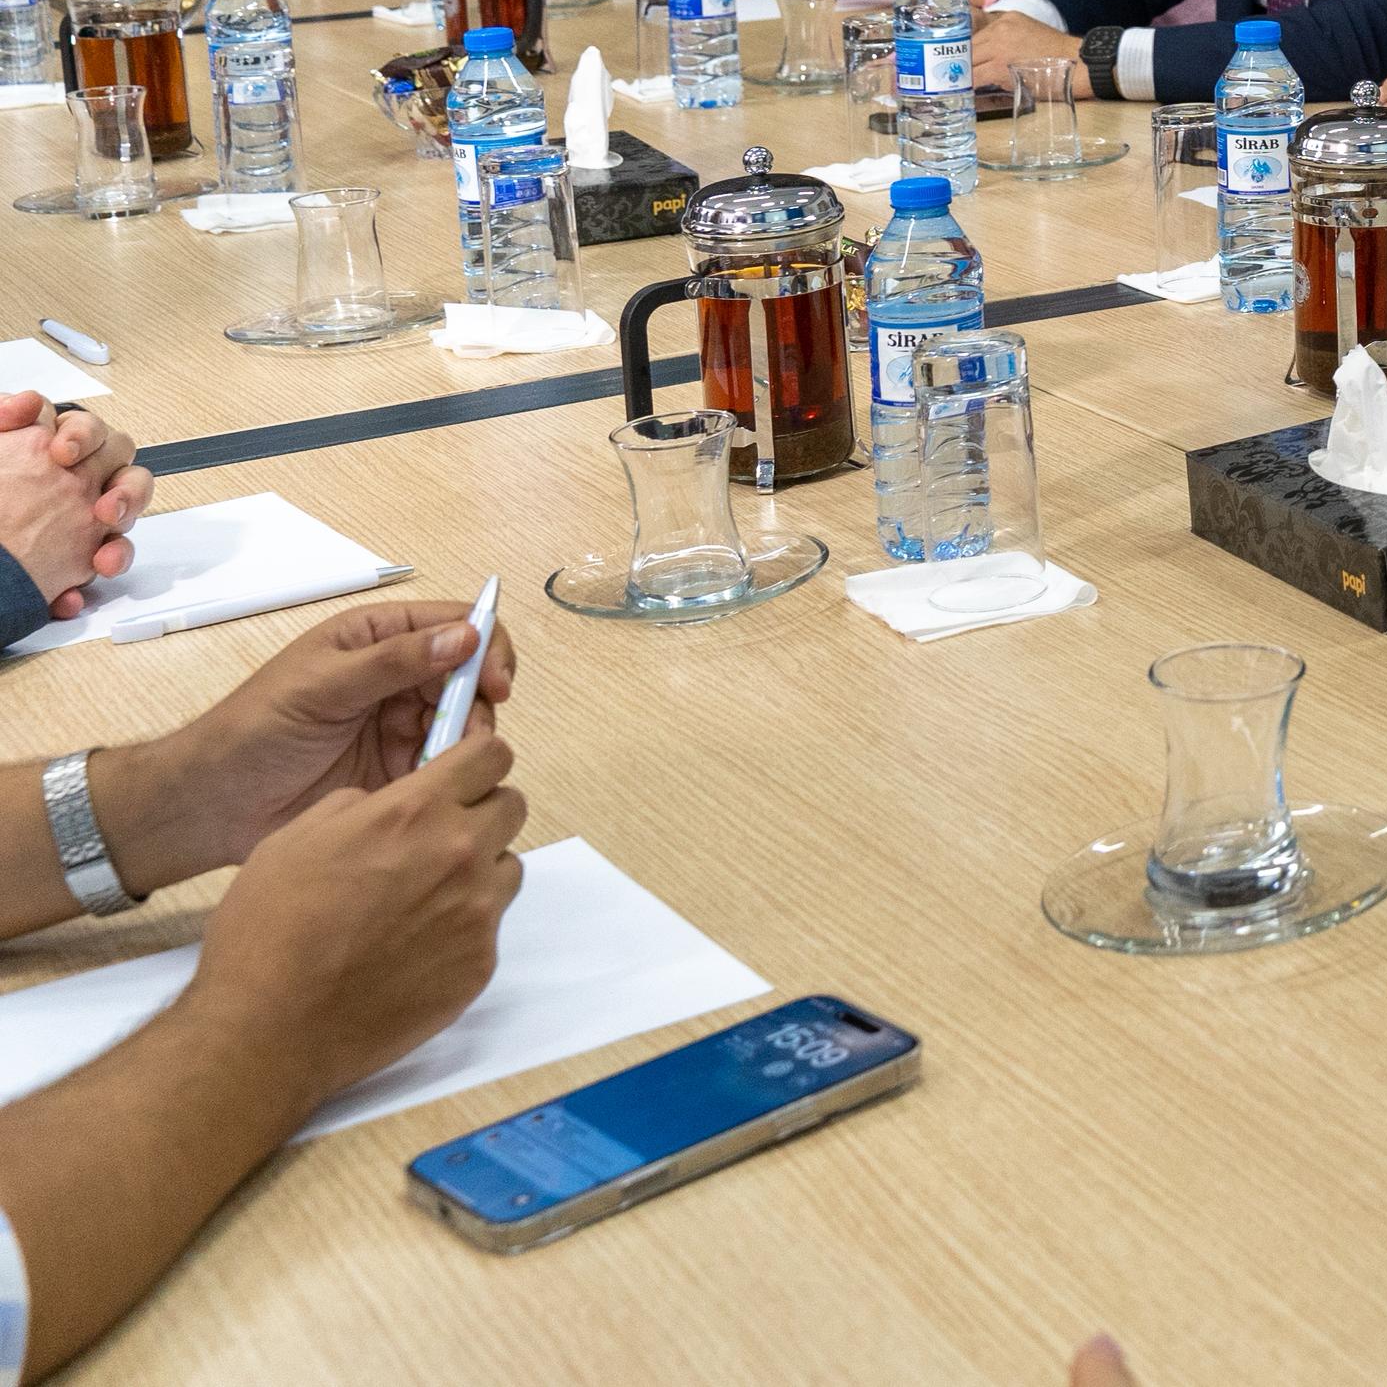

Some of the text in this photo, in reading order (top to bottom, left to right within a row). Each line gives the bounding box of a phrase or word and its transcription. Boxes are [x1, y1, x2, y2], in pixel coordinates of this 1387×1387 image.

[933, 44, 968, 56] SİRAB
[1235, 137, 1280, 150] SİRAB
[653, 193, 687, 216] papi
[1342, 569, 1366, 598] papi
